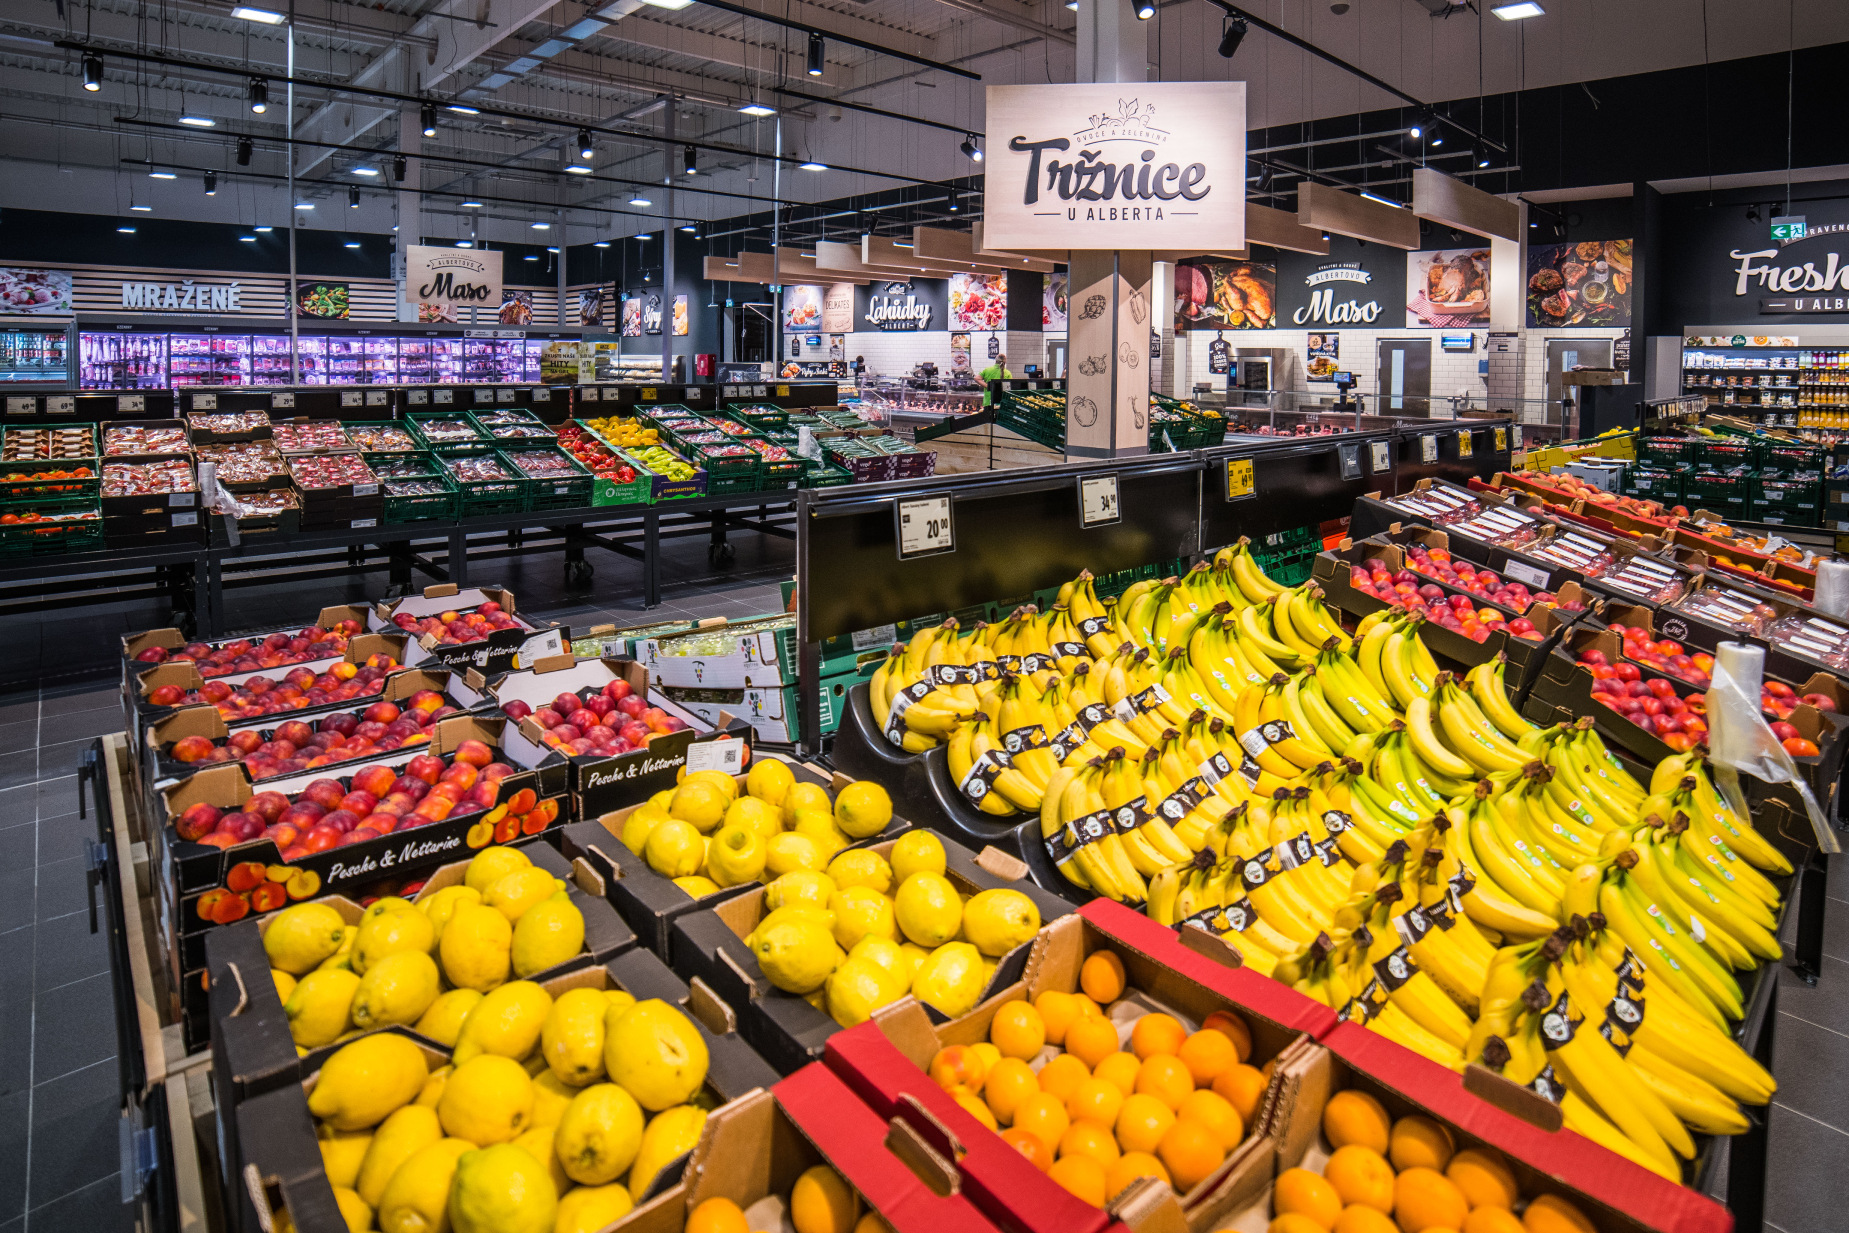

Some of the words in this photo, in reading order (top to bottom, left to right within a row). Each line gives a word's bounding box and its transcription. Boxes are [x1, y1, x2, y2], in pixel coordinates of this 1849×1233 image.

[1076, 131, 1106, 143] OVOCE
[1121, 129, 1168, 142] ZELENINA
[1008, 136, 1211, 206] Tržnice
[1067, 207, 1076, 221] U
[1086, 207, 1164, 221] ALBERTA
[1315, 271, 1360, 281] ALBERTOVO
[122, 279, 241, 311] MRAŽENÉ
[419, 272, 491, 301] Maso
[1293, 288, 1383, 325] Maso
[1794, 299, 1804, 310] U
[550, 360, 570, 368] HITY
[1101, 494, 1110, 511] 34
[926, 519, 939, 539] 20
[940, 518, 948, 529] 00
[443, 652, 470, 665] Pesche
[588, 767, 624, 789] Pesche
[626, 763, 638, 779] &
[639, 754, 685, 776] Nettarine
[327, 855, 378, 884] Pesche
[380, 849, 397, 868] &
[398, 835, 461, 863] Nettarine
